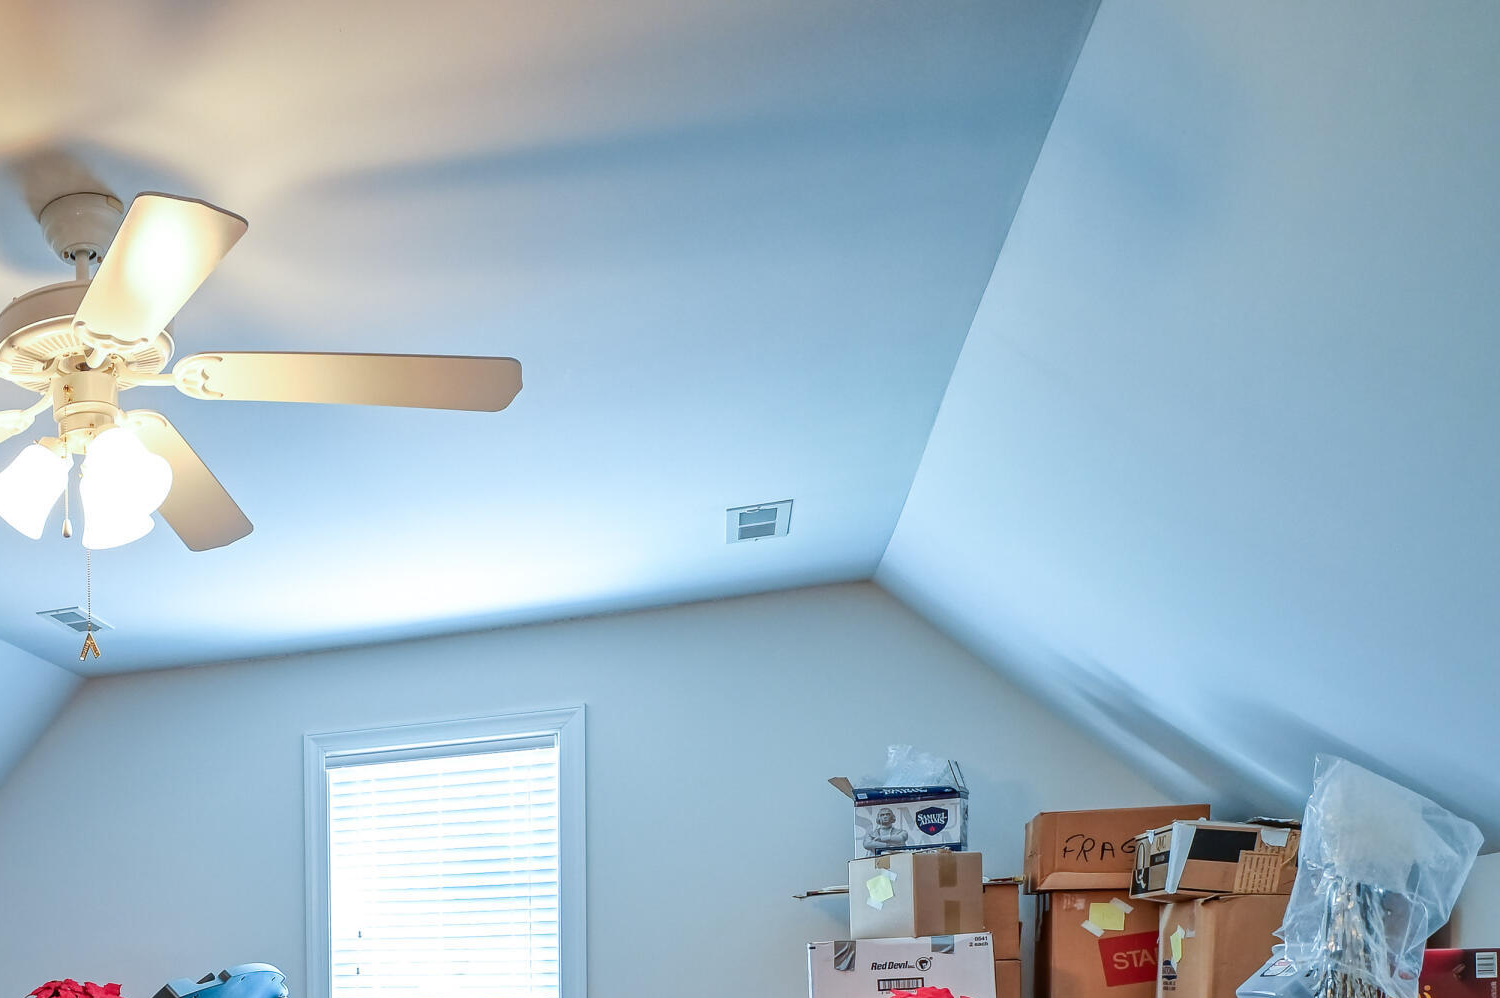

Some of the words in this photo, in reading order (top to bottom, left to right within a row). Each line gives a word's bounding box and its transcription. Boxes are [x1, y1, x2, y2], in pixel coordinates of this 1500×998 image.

[1062, 834, 1138, 863] FRAG
[871, 963, 887, 971] Red
[888, 961, 908, 970] Devil
